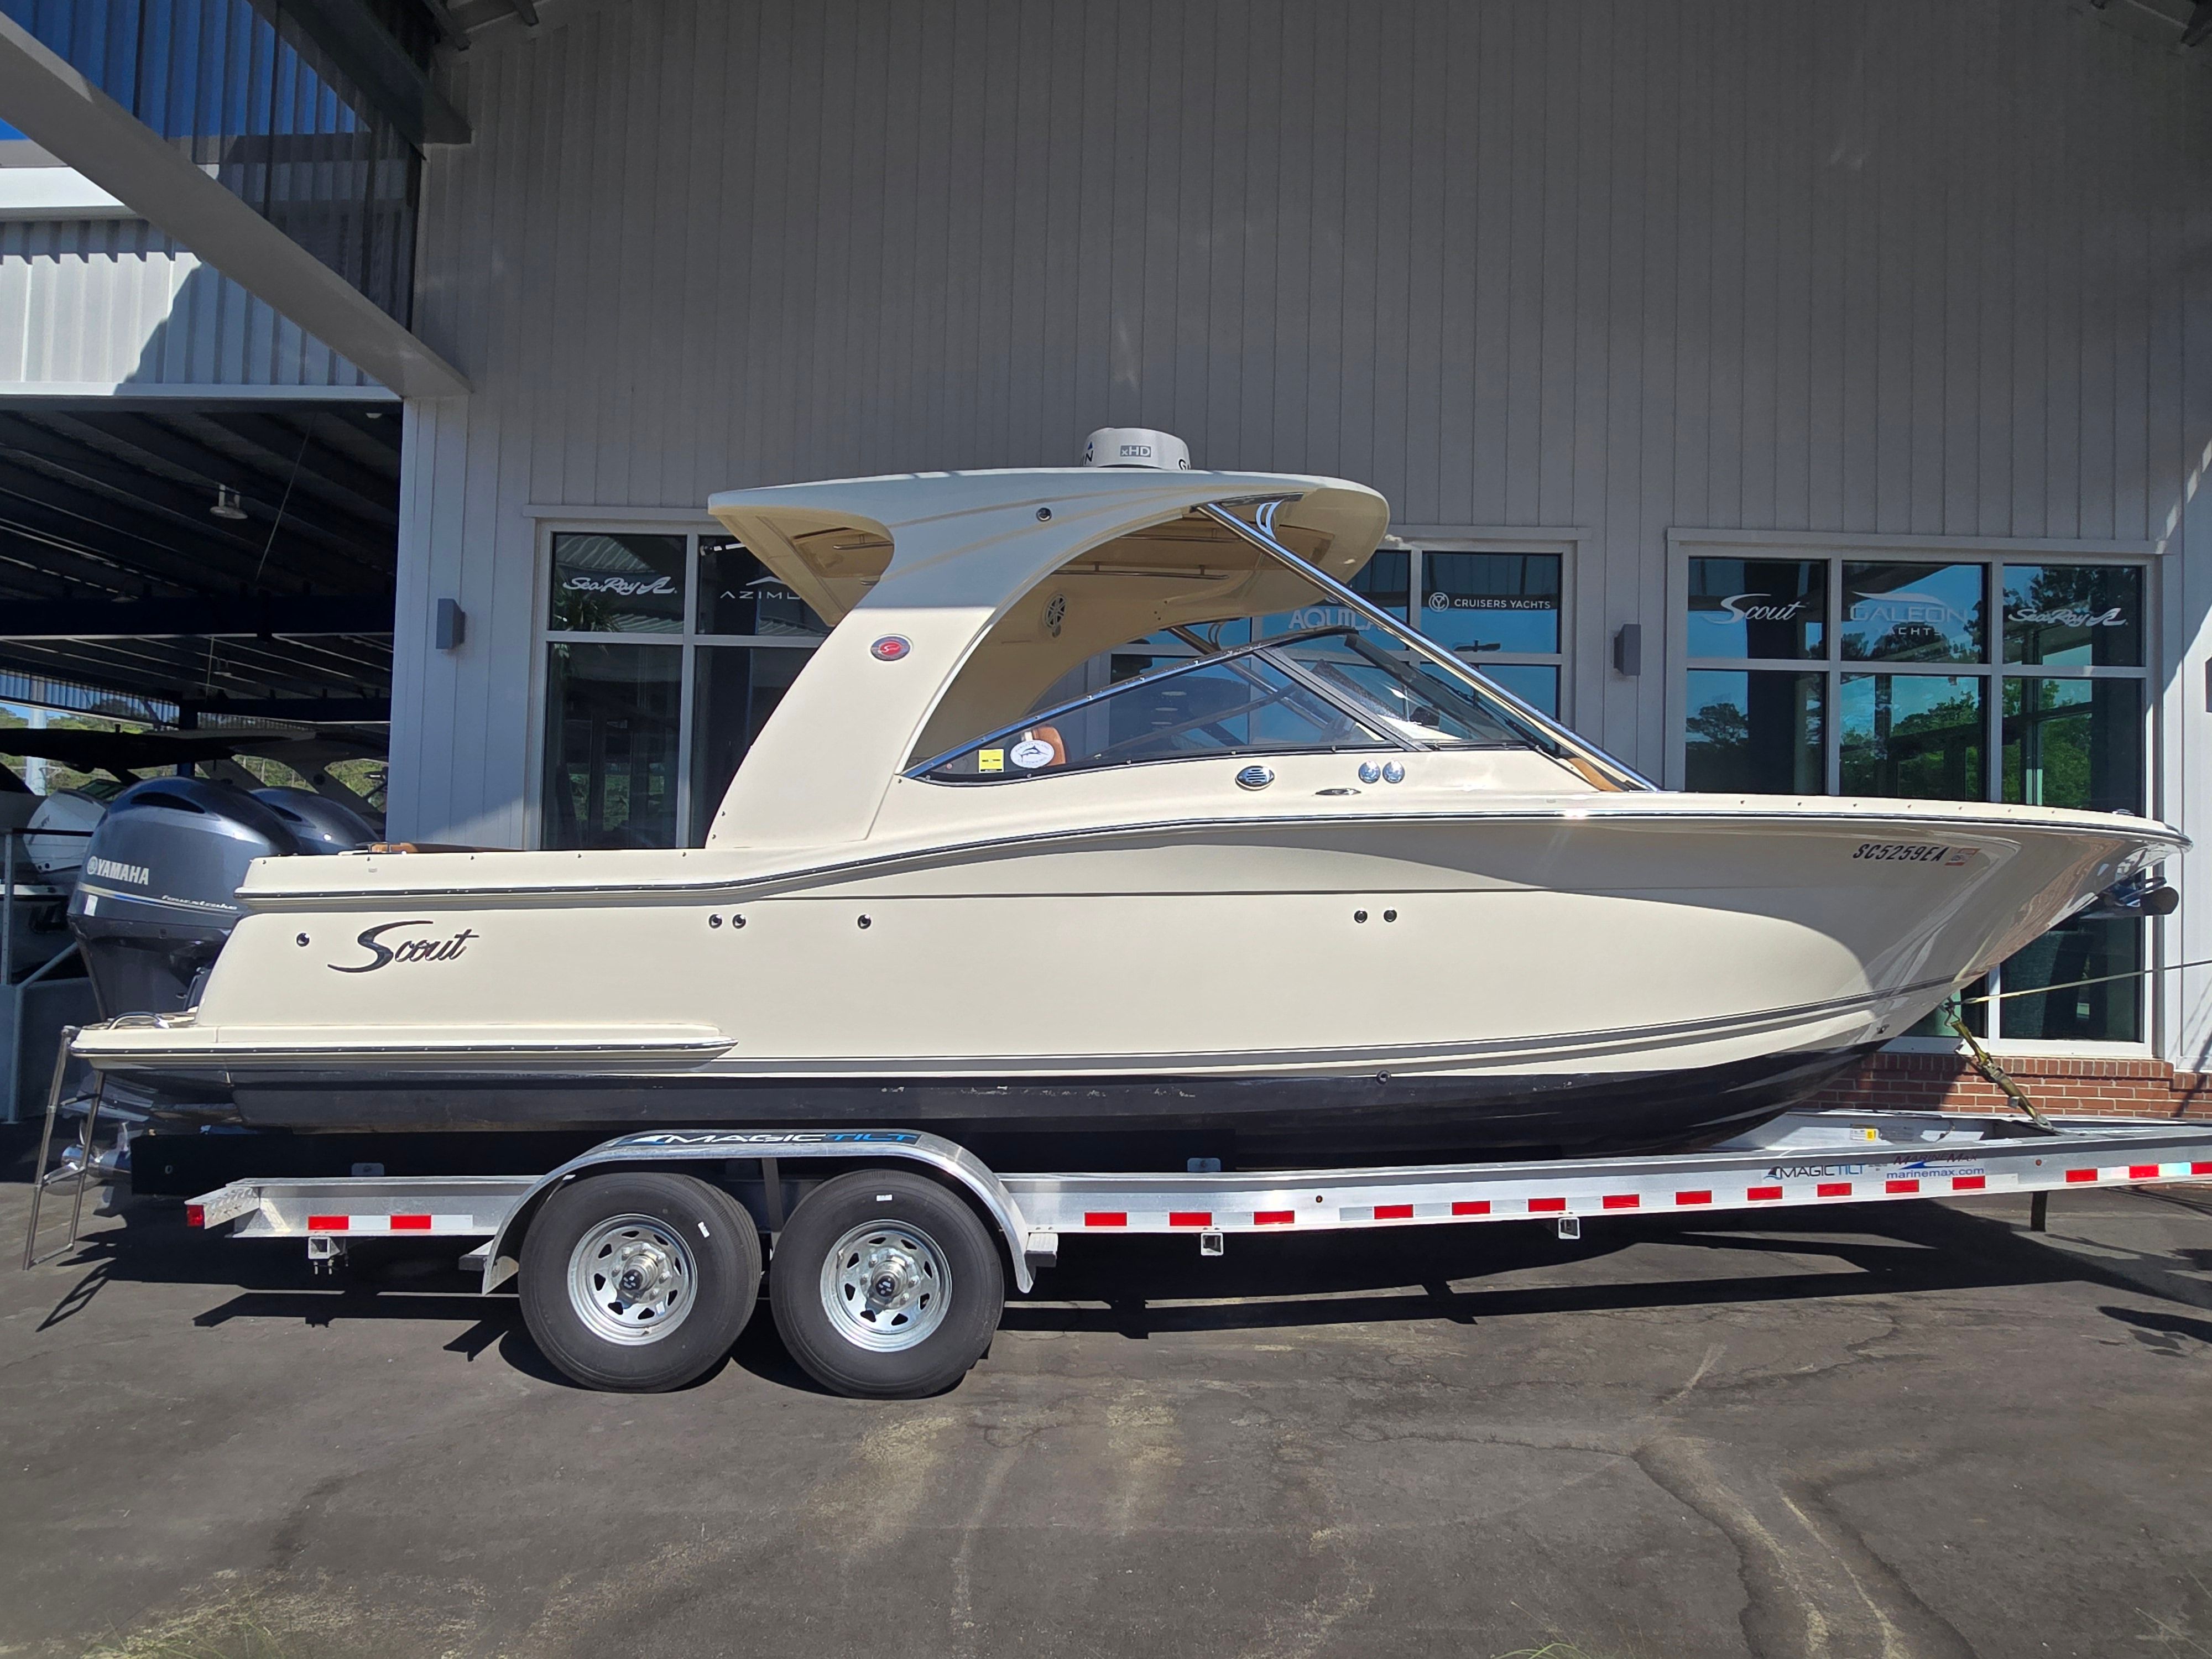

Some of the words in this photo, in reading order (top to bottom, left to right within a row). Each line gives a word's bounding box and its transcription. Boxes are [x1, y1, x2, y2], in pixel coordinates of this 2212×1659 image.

[1121, 446, 1150, 456] xHD
[719, 591, 801, 599] AZIMU
[1454, 598, 1507, 608] CRUISERS
[1510, 600, 1551, 609] YACHTS
[1700, 593, 1807, 624] Scout
[1850, 605, 1967, 623] GALEON
[1853, 844, 1950, 862] SC5259EA
[97, 858, 149, 885] YAMAHA
[327, 920, 479, 973] Scout
[1886, 1166, 1985, 1179] marinemax.com
